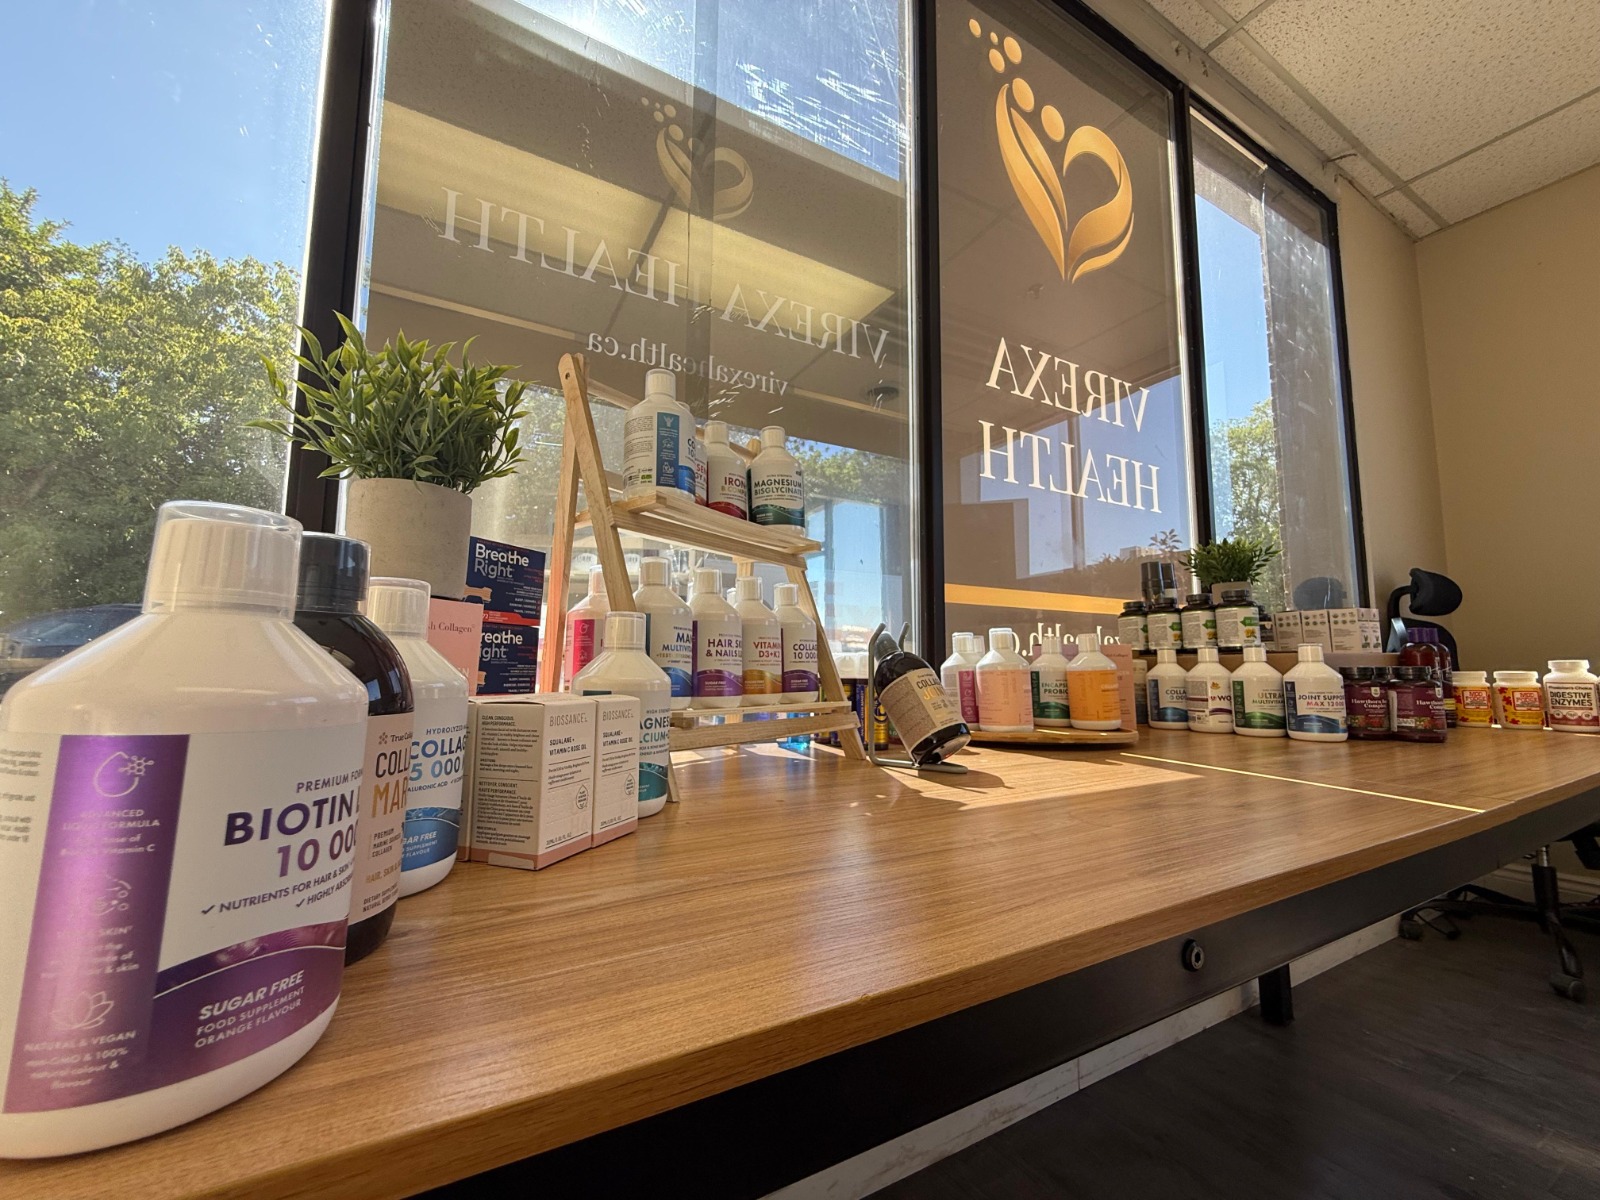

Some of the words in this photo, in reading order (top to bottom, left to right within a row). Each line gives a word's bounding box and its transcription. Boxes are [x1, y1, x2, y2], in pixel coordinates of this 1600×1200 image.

[754, 478, 802, 489] MAGNESIUM
[475, 543, 529, 567] Breathe
[474, 558, 511, 579] Right
[438, 621, 472, 635] Collagen
[481, 629, 523, 645] reathe
[676, 632, 692, 644] MA
[705, 649, 713, 658] &
[715, 649, 738, 658] NAILS
[793, 651, 803, 660] 10
[1550, 691, 1592, 699] DIGESTIVE
[1551, 698, 1593, 706] ENZYMES
[549, 712, 586, 727] BIOSSANCE
[602, 708, 632, 721] BIOSSANCE
[409, 762, 424, 782] 5
[430, 756, 461, 779] 000
[296, 773, 349, 794] PREMIUM
[407, 782, 437, 793] ALURONIC
[224, 789, 355, 846] BIOTIN
[373, 827, 394, 841] PREMIUM
[420, 830, 438, 842] FREE
[146, 843, 156, 852] C
[372, 845, 393, 858] COLLAGEN
[277, 838, 320, 878] 10
[218, 887, 290, 913] NUTRIENTS
[292, 880, 312, 895] FOR
[313, 872, 332, 886] HAIR
[332, 869, 338, 878] &
[338, 863, 350, 875] SKIN
[306, 884, 335, 905] HIGHLY
[198, 985, 267, 1021] SUGAR
[269, 969, 305, 996] FREE
[196, 1015, 236, 1036] FOOD
[238, 985, 305, 1022] SUPPLEMENT
[194, 1020, 253, 1049] ORANGE
[255, 997, 302, 1027] FLAVOUR
[91, 1029, 137, 1045] VEGAN
